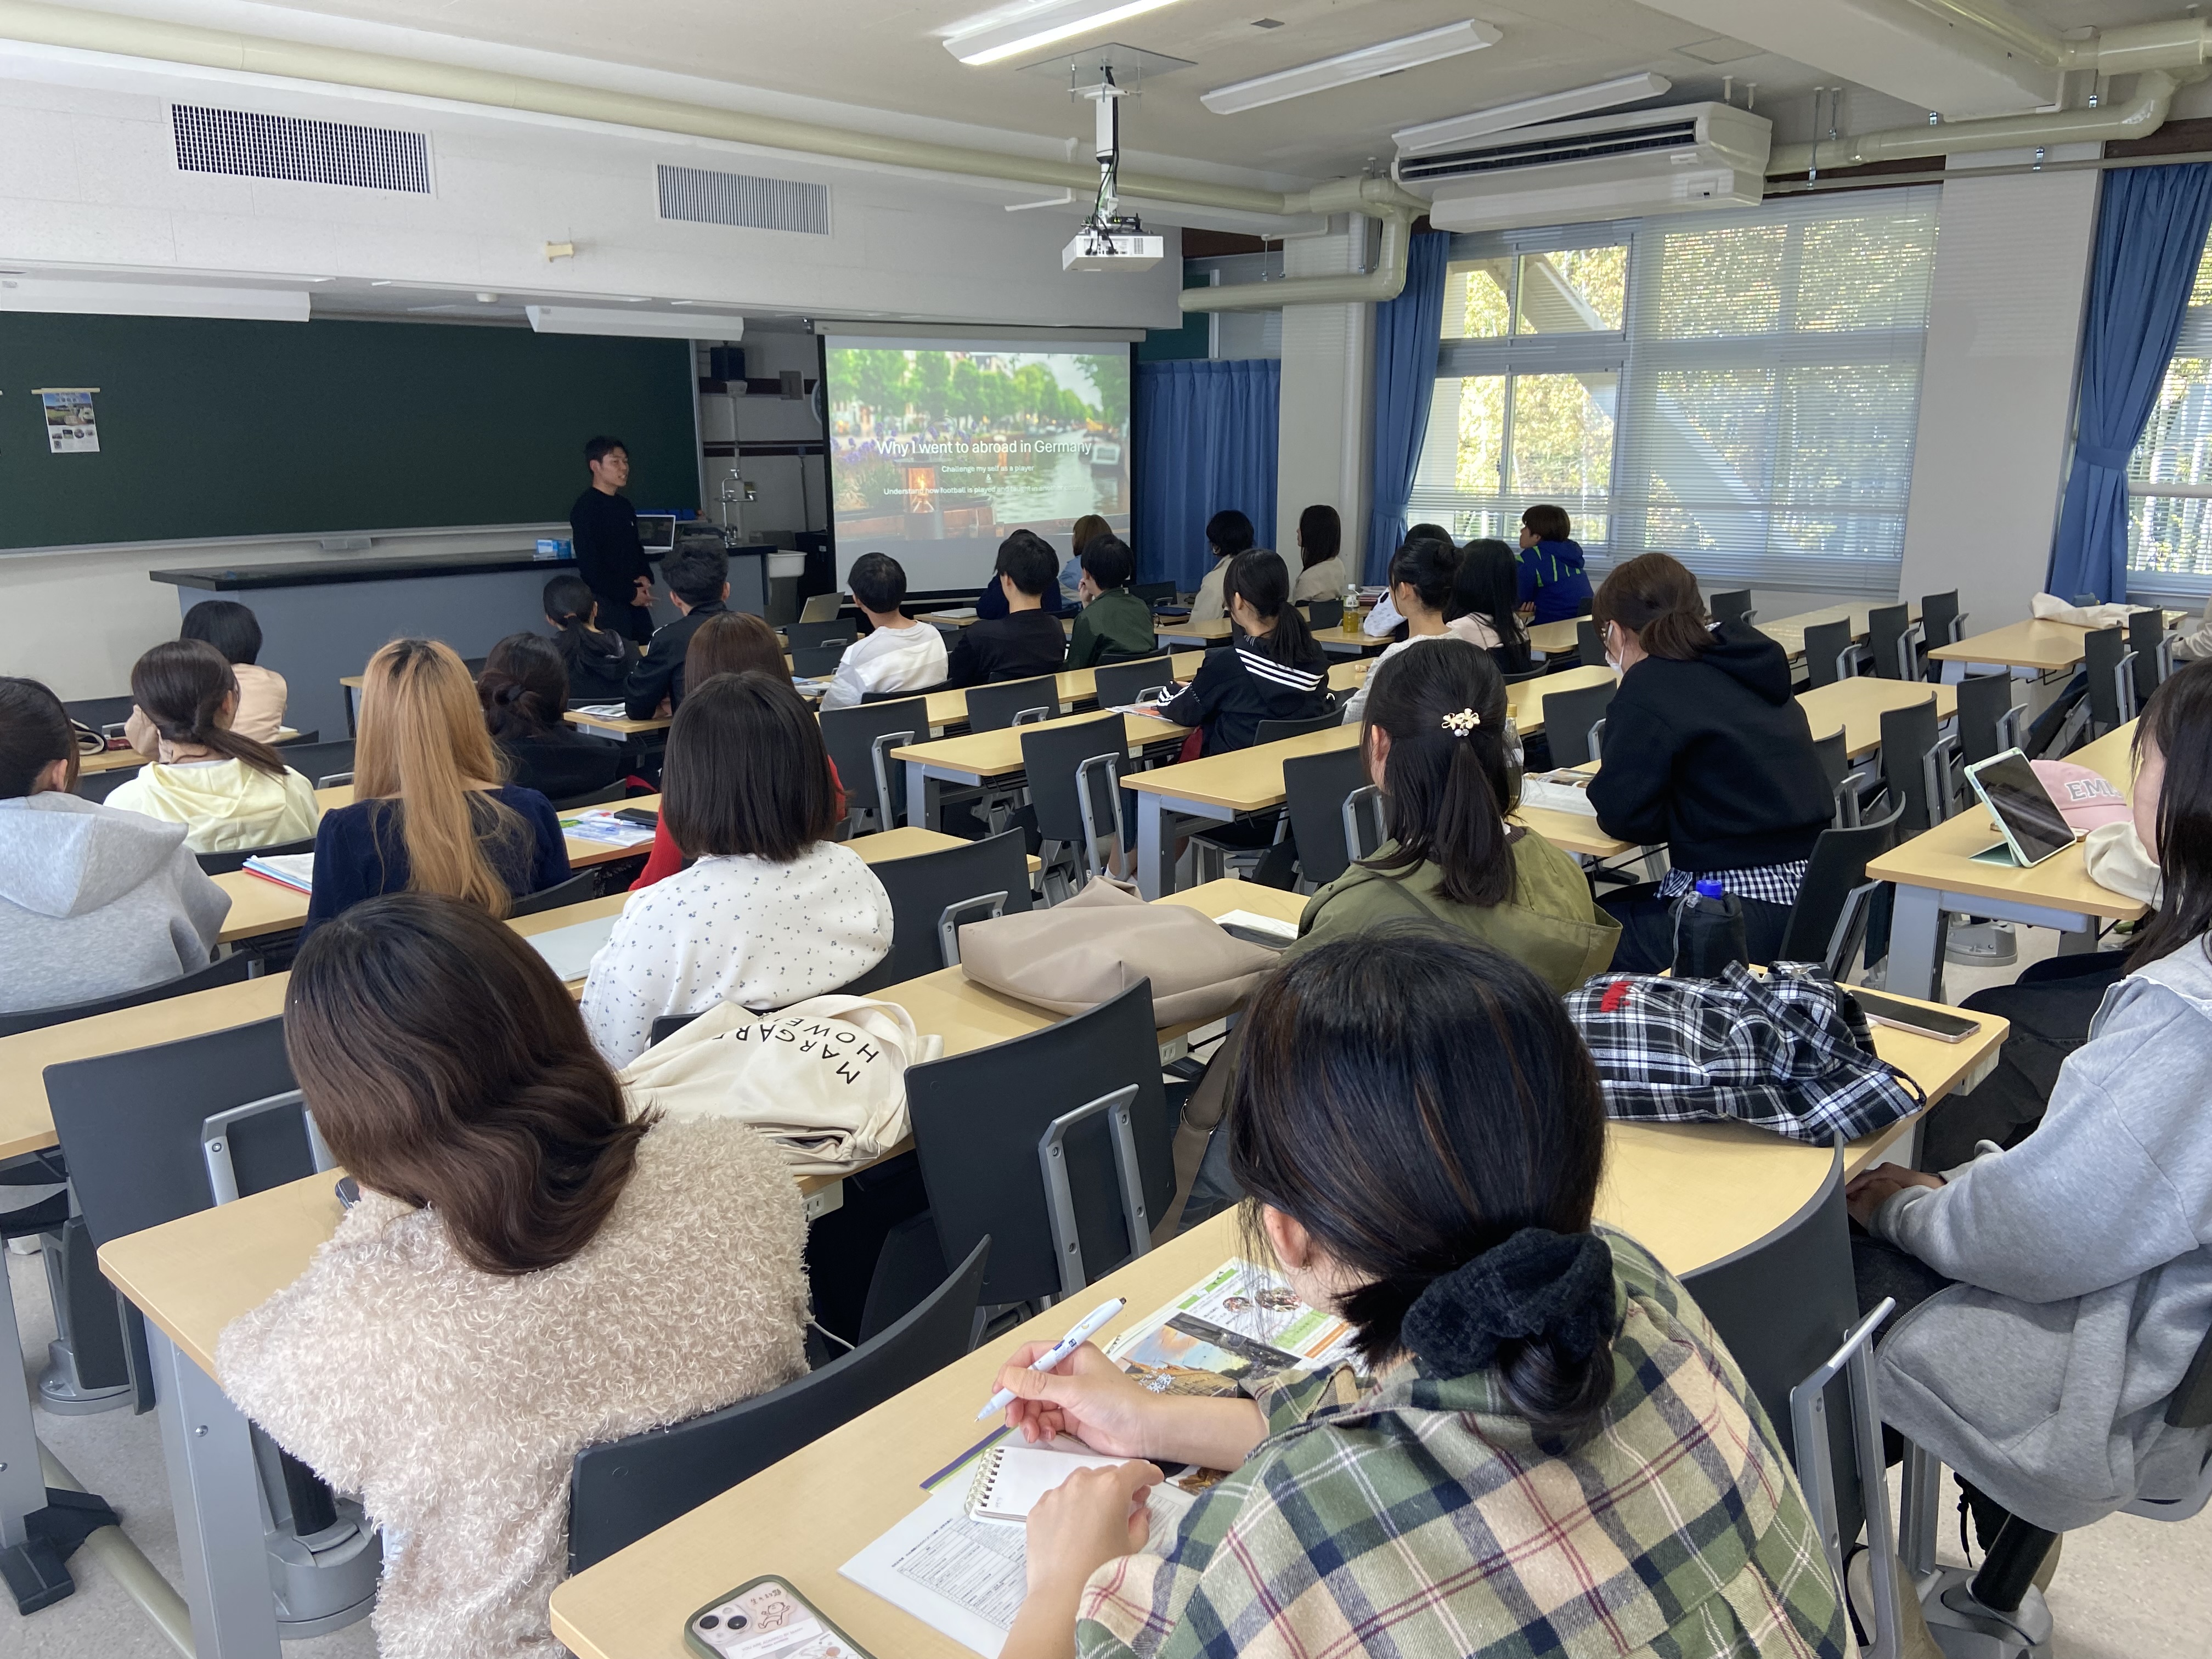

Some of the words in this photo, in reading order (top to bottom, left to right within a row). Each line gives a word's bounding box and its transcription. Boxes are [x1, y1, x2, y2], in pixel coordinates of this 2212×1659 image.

[877, 441, 909, 457] Why
[912, 441, 916, 454] I
[918, 441, 953, 454] went
[955, 441, 969, 454] to
[972, 440, 1017, 453] abroad
[1020, 439, 1031, 453] in
[1035, 440, 1092, 455] Germany
[941, 465, 975, 473] Challenge
[974, 486, 996, 494] played
[774, 1018, 879, 1063] HOWE
[712, 1024, 861, 1085] MARGAR
